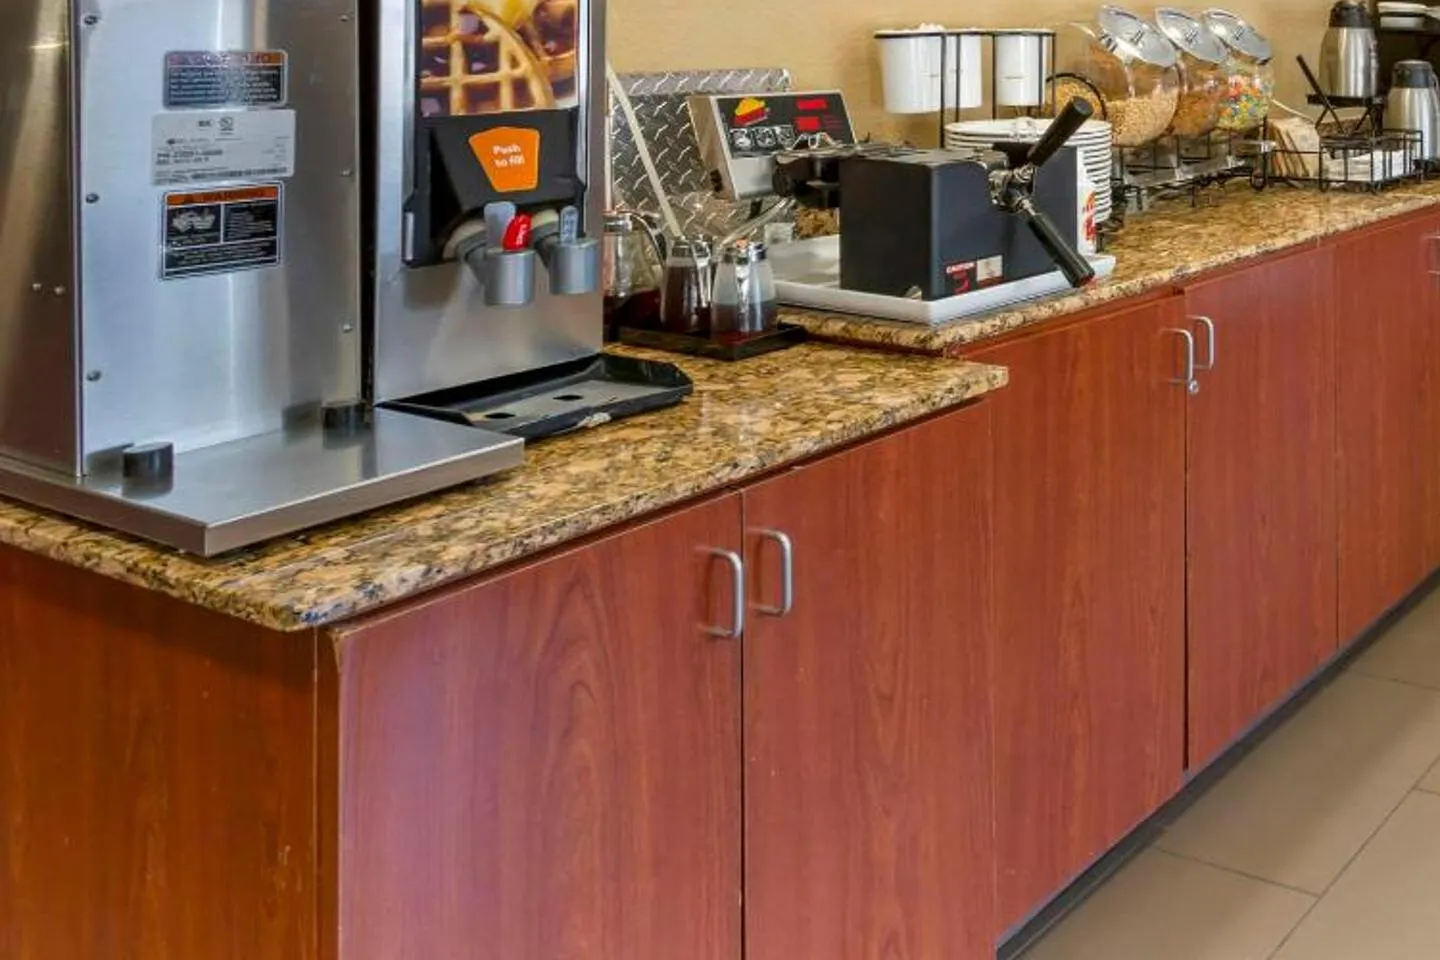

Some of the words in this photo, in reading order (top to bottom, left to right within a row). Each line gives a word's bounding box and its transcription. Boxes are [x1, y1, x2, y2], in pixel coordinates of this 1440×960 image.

[493, 143, 521, 155] Push
[494, 158, 508, 168] to
[509, 154, 525, 165] fill
